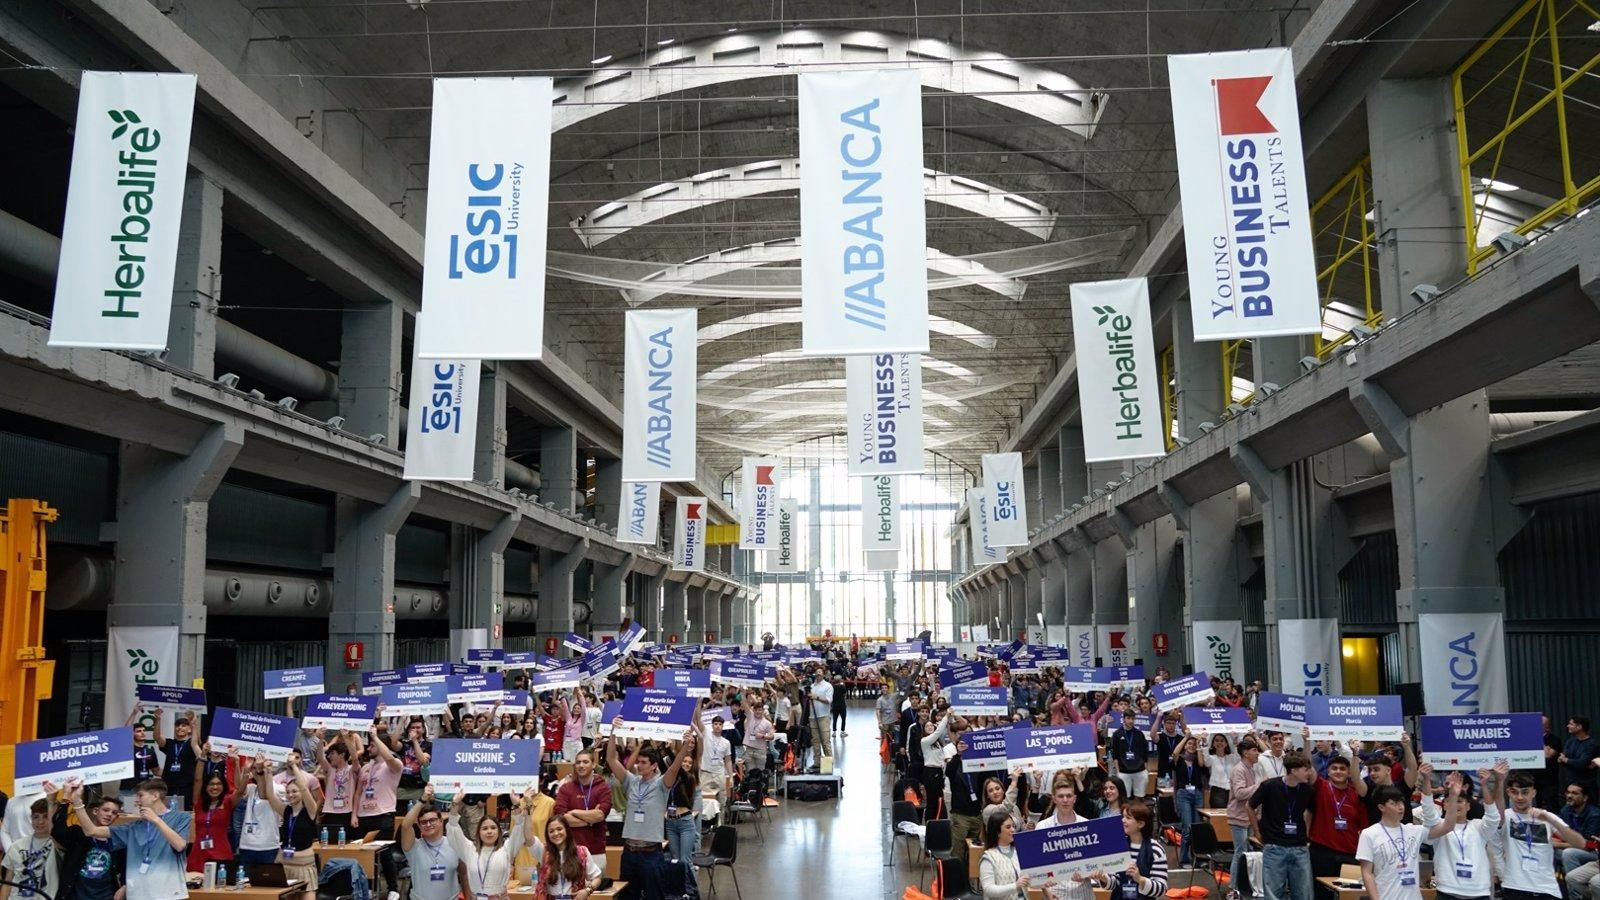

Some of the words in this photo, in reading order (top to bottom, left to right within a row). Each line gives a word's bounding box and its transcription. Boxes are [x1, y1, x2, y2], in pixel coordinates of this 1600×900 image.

[507, 162, 525, 230] University
[102, 127, 161, 318] Herbalife
[1227, 139, 1274, 318] BUSINESS
[455, 363, 466, 404] University
[1106, 314, 1142, 440] Herbalife
[876, 353, 896, 464] BUSINESS
[756, 486, 766, 544] BUSINESS
[877, 476, 891, 541] Herbalife
[685, 520, 696, 566] BUSINESS
[779, 512, 790, 566] Herbalife
[1080, 632, 1090, 668] ANCA
[1214, 643, 1232, 679] alife
[1449, 632, 1479, 714] NCA
[642, 704, 671, 714] ASYSKIN
[1280, 703, 1306, 713] MOLINE
[1330, 706, 1377, 716] LOSCHIWIS
[240, 722, 270, 734] KEIZHAI
[974, 740, 1006, 750] LOTIGUER
[1026, 735, 1072, 748] LAS_POPUS
[1453, 728, 1511, 739] WANABIES
[40, 742, 109, 762] PARBOLEDAS
[456, 752, 516, 765] SUNSHINE_S
[1042, 834, 1100, 853] ALMINAR12
[1047, 829, 1067, 838] Colegio
[1068, 826, 1088, 834] Alminar
[1064, 850, 1082, 860] Sevilla
